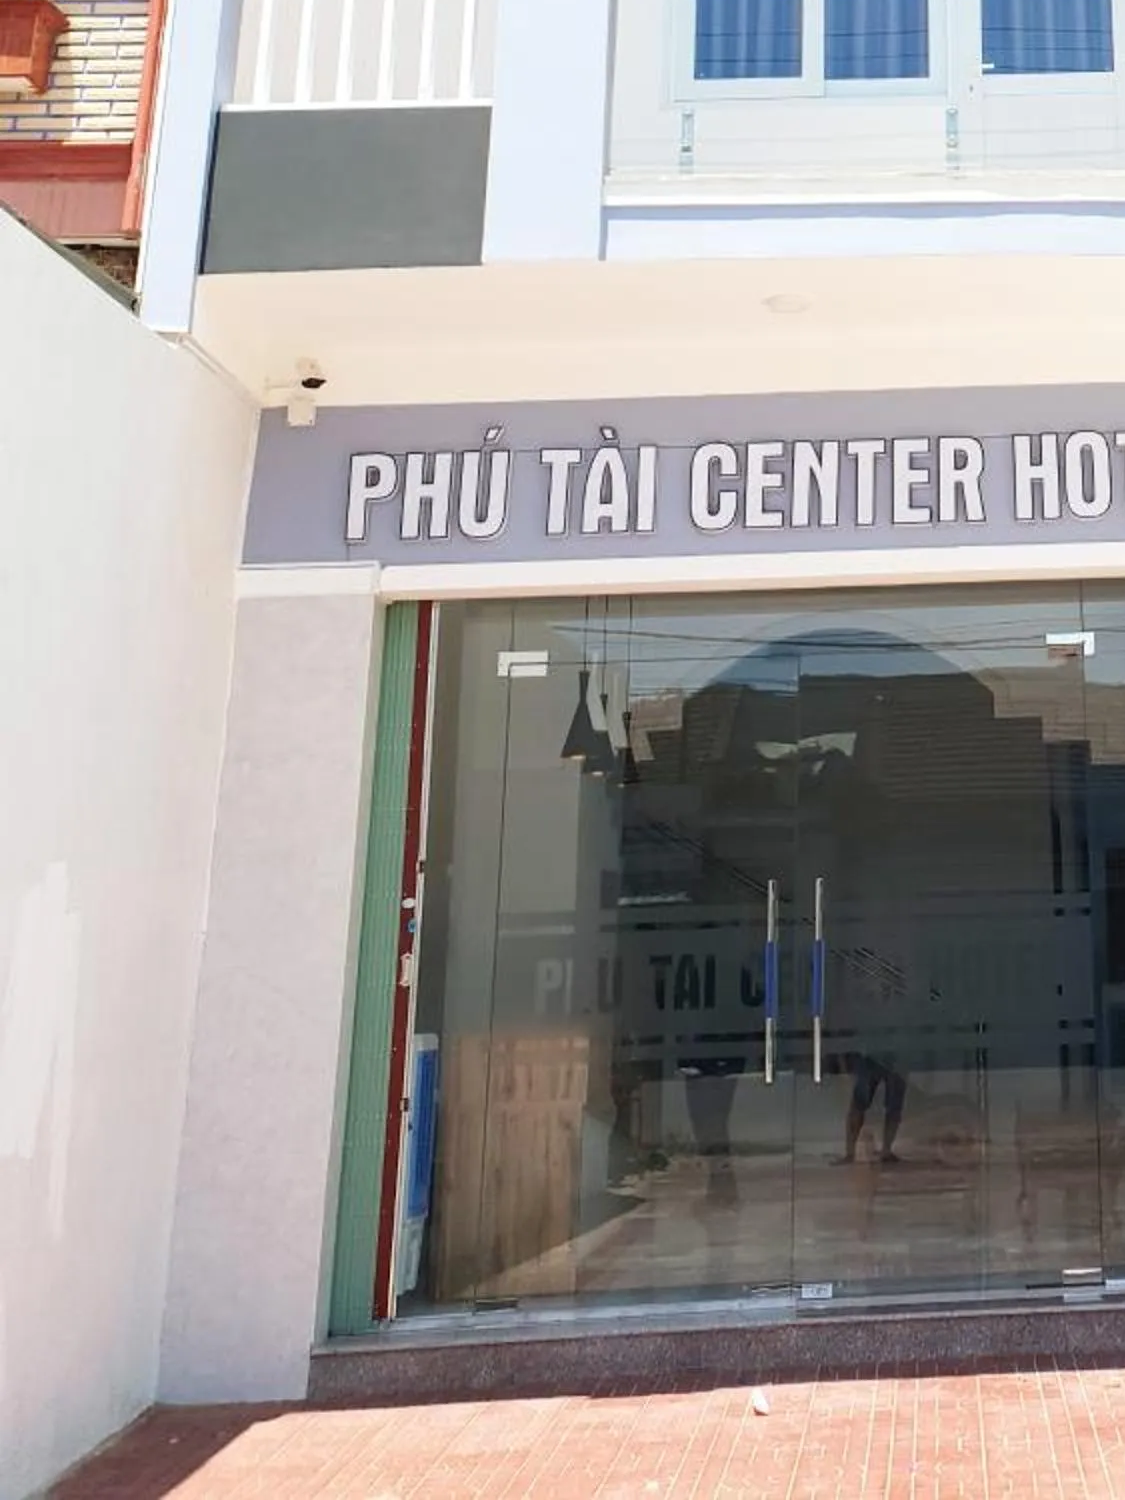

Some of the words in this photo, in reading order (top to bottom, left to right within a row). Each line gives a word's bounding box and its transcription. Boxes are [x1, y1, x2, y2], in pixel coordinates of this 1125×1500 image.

[345, 426, 512, 542] PHÚ
[540, 426, 657, 537] TÀI
[690, 435, 987, 534] CENTER
